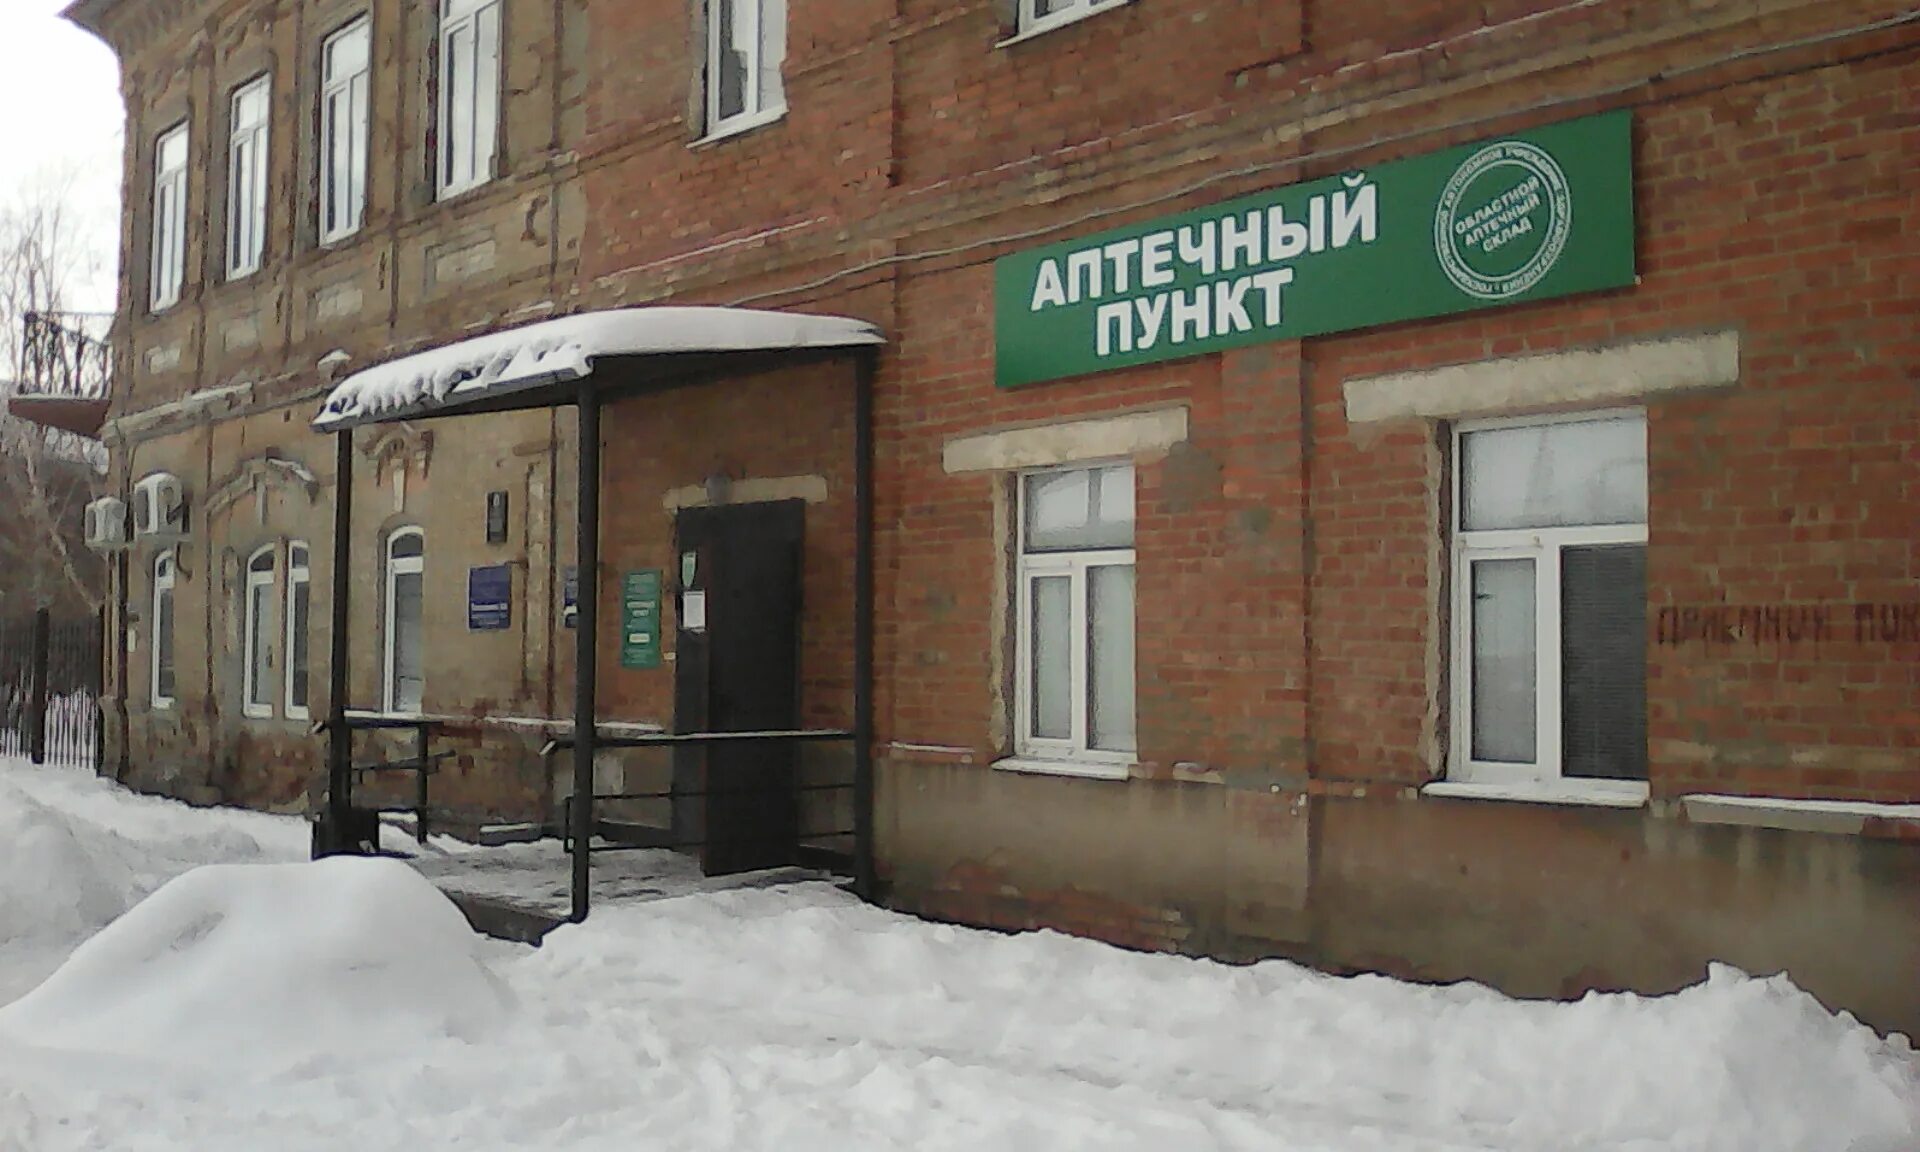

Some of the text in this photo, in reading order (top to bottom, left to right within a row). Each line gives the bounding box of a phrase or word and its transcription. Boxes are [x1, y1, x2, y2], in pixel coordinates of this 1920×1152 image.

[1031, 173, 1378, 311] АПТЕЧНЫЙ
[1465, 193, 1541, 247] АПТЕЧНЫЙ
[1483, 216, 1534, 253] СКЛАД
[1096, 268, 1294, 357] ПУНКТ
